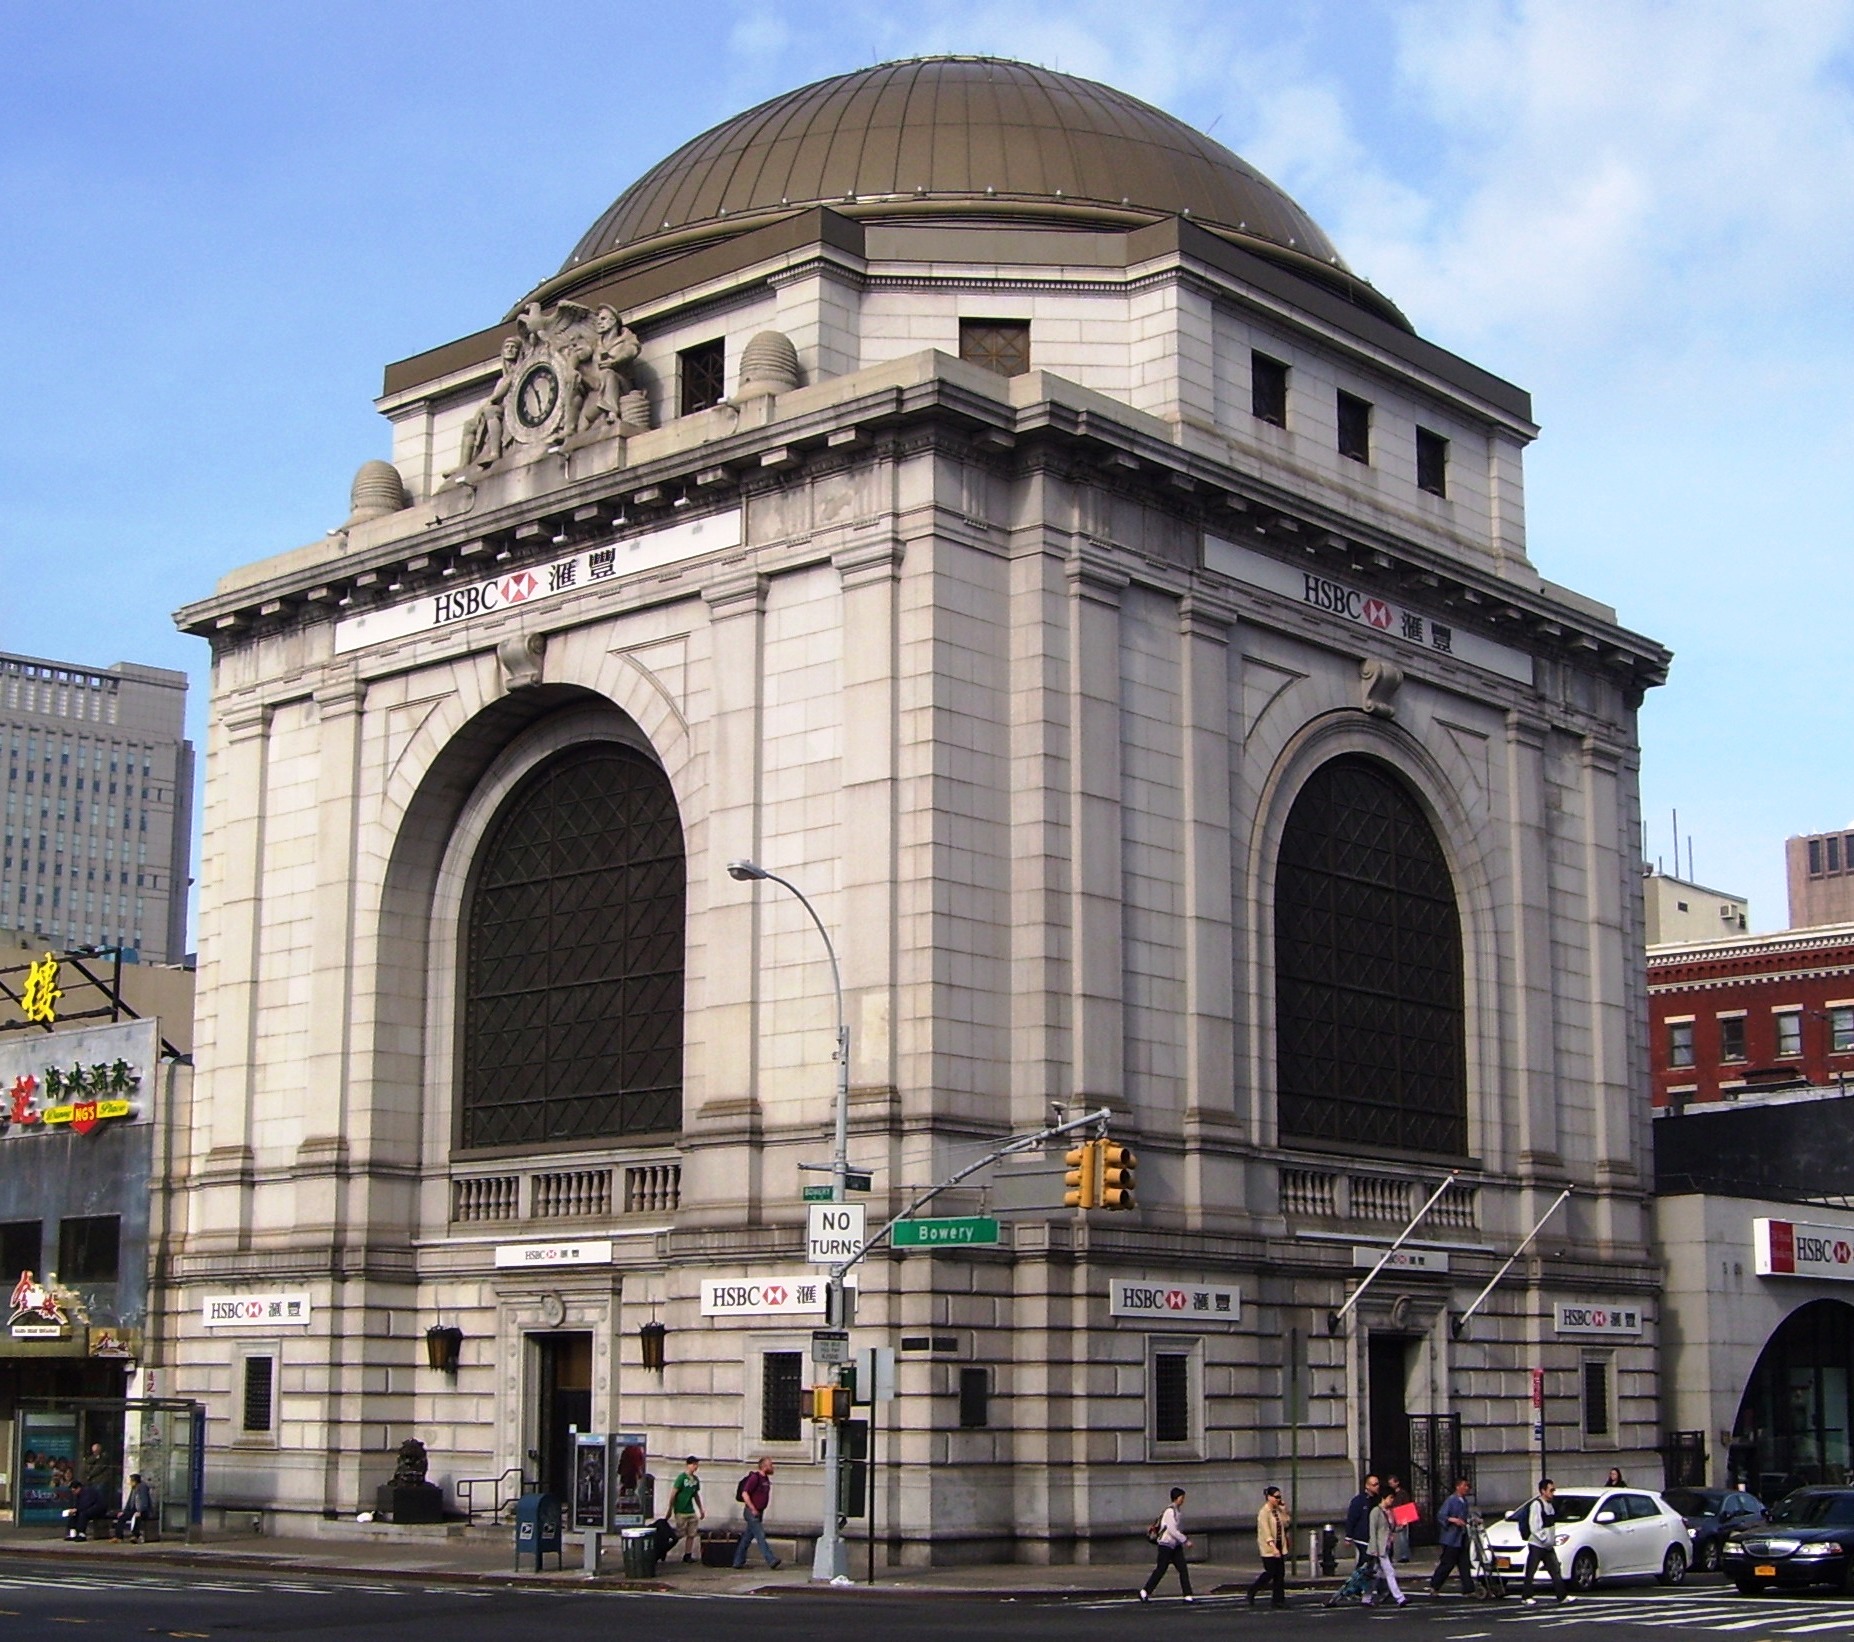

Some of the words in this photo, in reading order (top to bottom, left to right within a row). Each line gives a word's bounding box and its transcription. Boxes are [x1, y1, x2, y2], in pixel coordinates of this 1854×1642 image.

[433, 580, 499, 625] HSBC
[1303, 573, 1362, 620] HSBC
[822, 1212, 851, 1231] NO
[919, 1226, 974, 1241] Bowery
[811, 1239, 862, 1256] TURNS
[1796, 1236, 1832, 1262] HSBC
[712, 1286, 761, 1307] HSBC
[1122, 1288, 1165, 1310] HSBC
[211, 1302, 245, 1319] HSBC
[1563, 1308, 1592, 1327] HSBC
